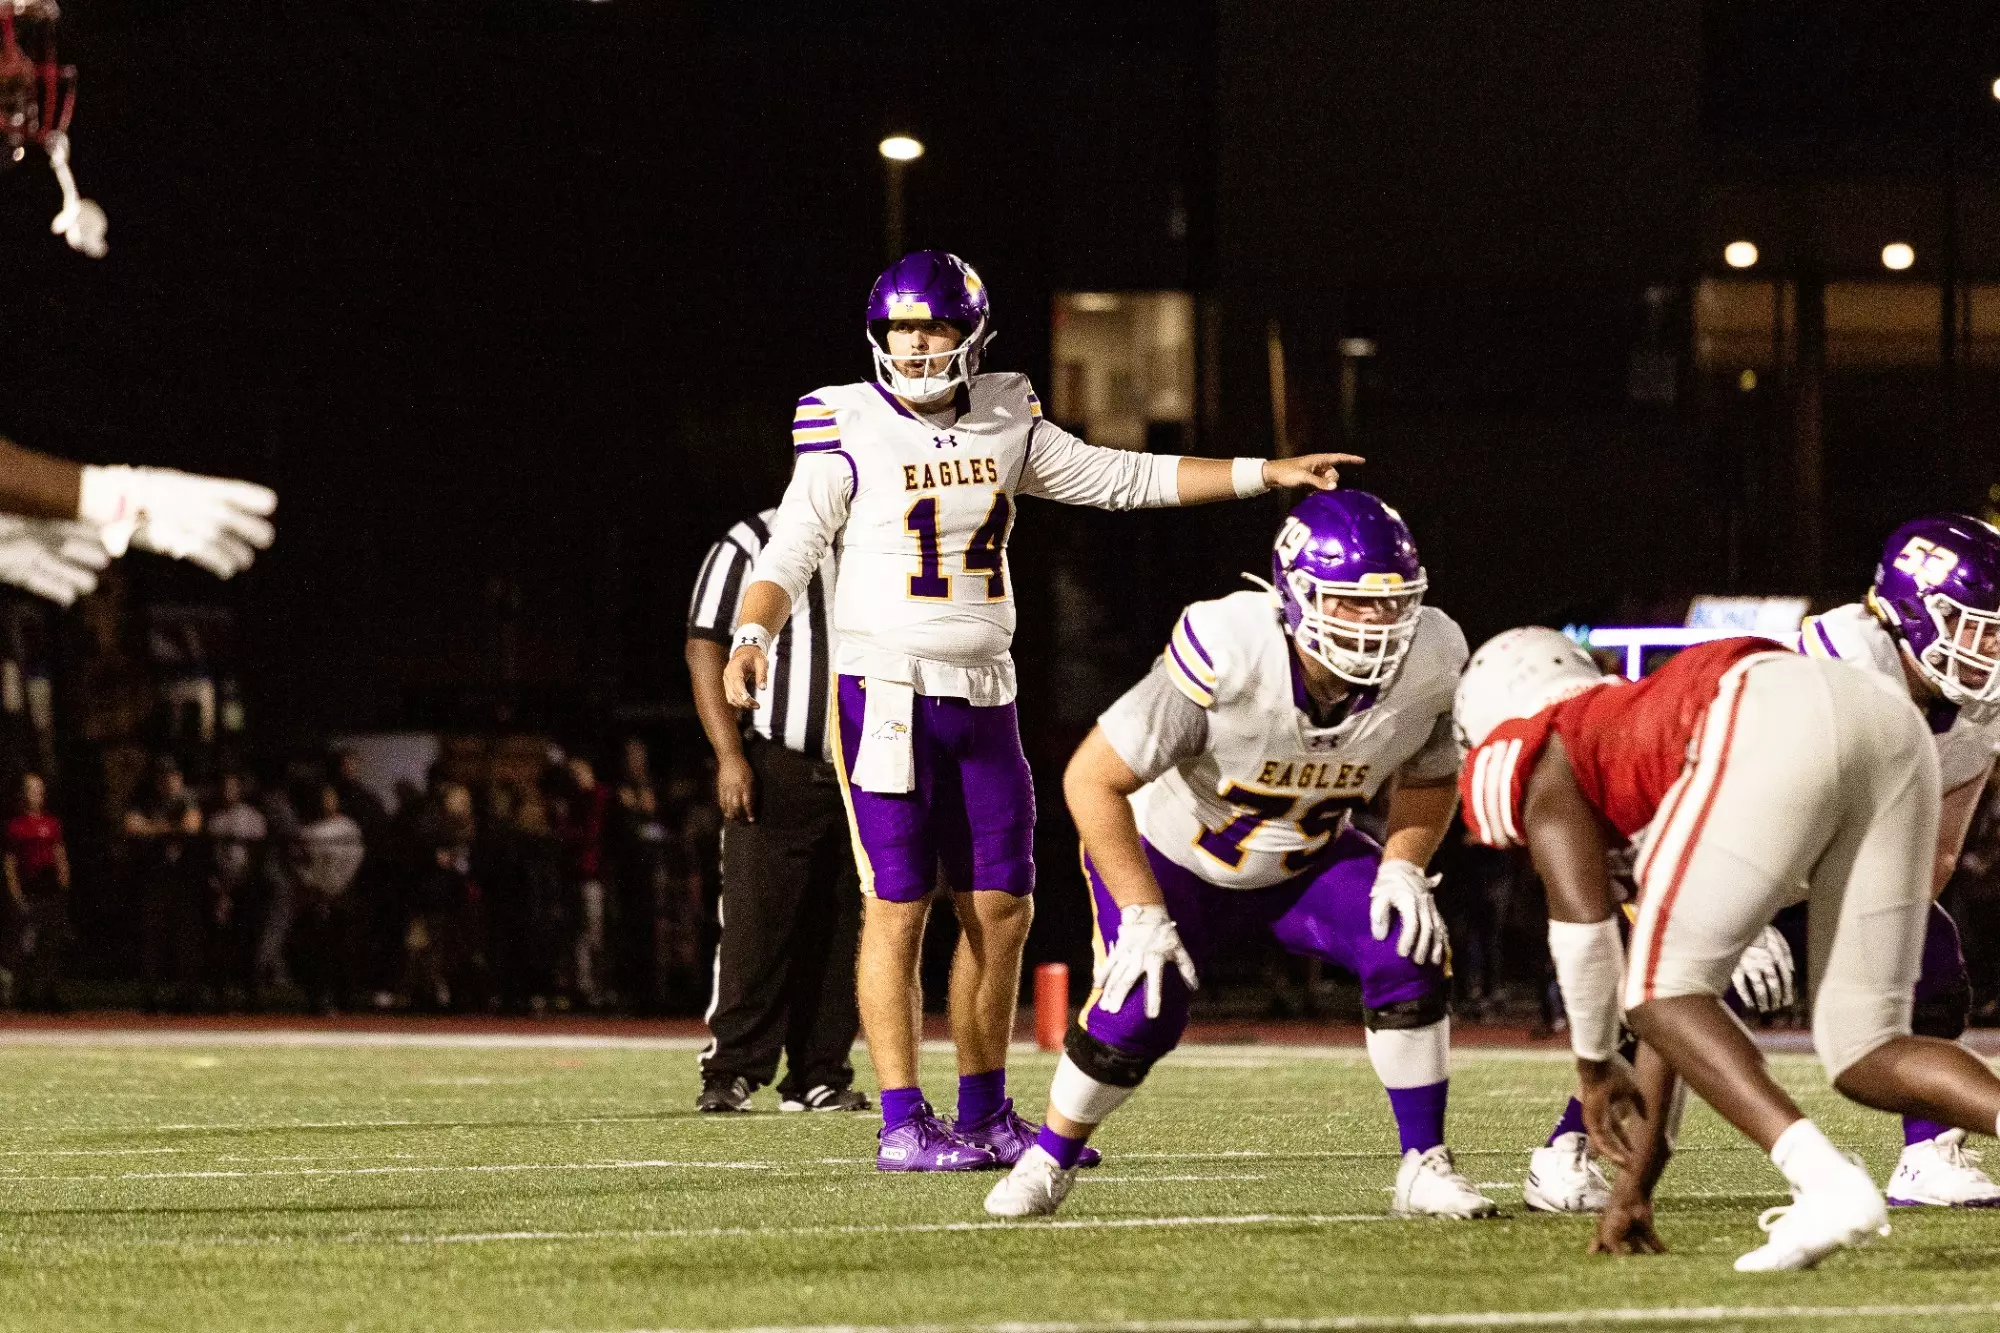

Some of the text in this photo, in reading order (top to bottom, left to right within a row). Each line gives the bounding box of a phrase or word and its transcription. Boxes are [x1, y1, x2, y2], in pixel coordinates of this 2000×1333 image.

[903, 457, 998, 491] EAGLES
[904, 489, 1013, 601] 14
[1893, 536, 1959, 590] 53
[1256, 760, 1371, 790] EAGLES
